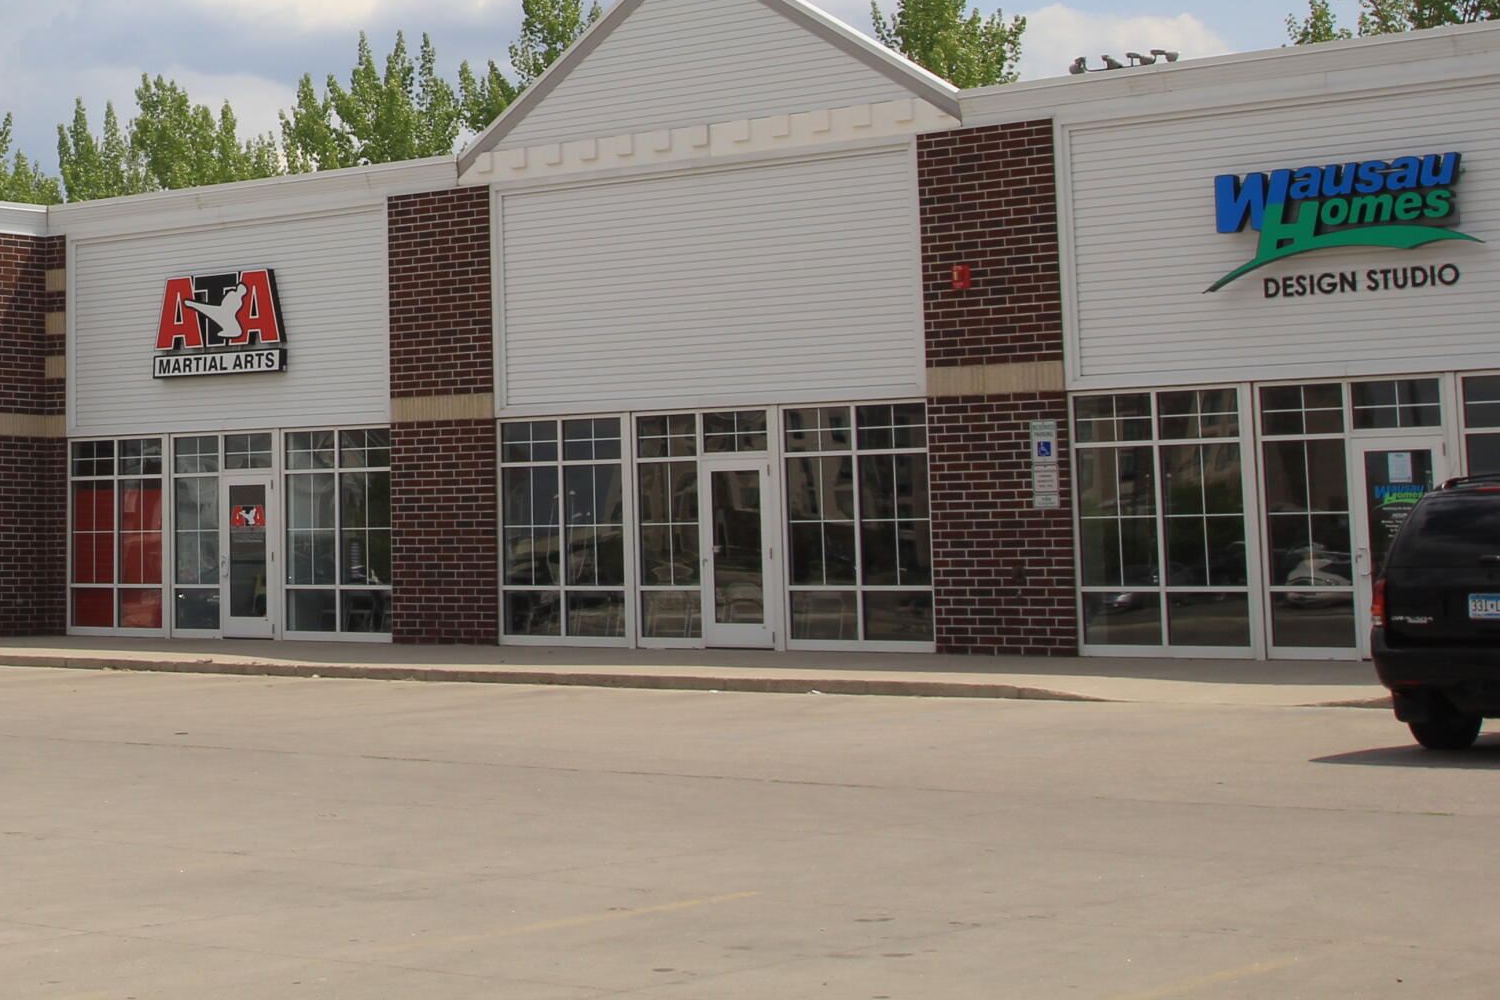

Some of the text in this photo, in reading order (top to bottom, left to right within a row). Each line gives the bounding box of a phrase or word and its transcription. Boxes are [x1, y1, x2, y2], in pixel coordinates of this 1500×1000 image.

[1214, 152, 1461, 233] Wausau
[1255, 189, 1456, 262] Homes
[155, 269, 286, 350] ATA
[1264, 263, 1460, 298] DESIGN STUDIO
[158, 352, 275, 374] MARTIAL ARTS
